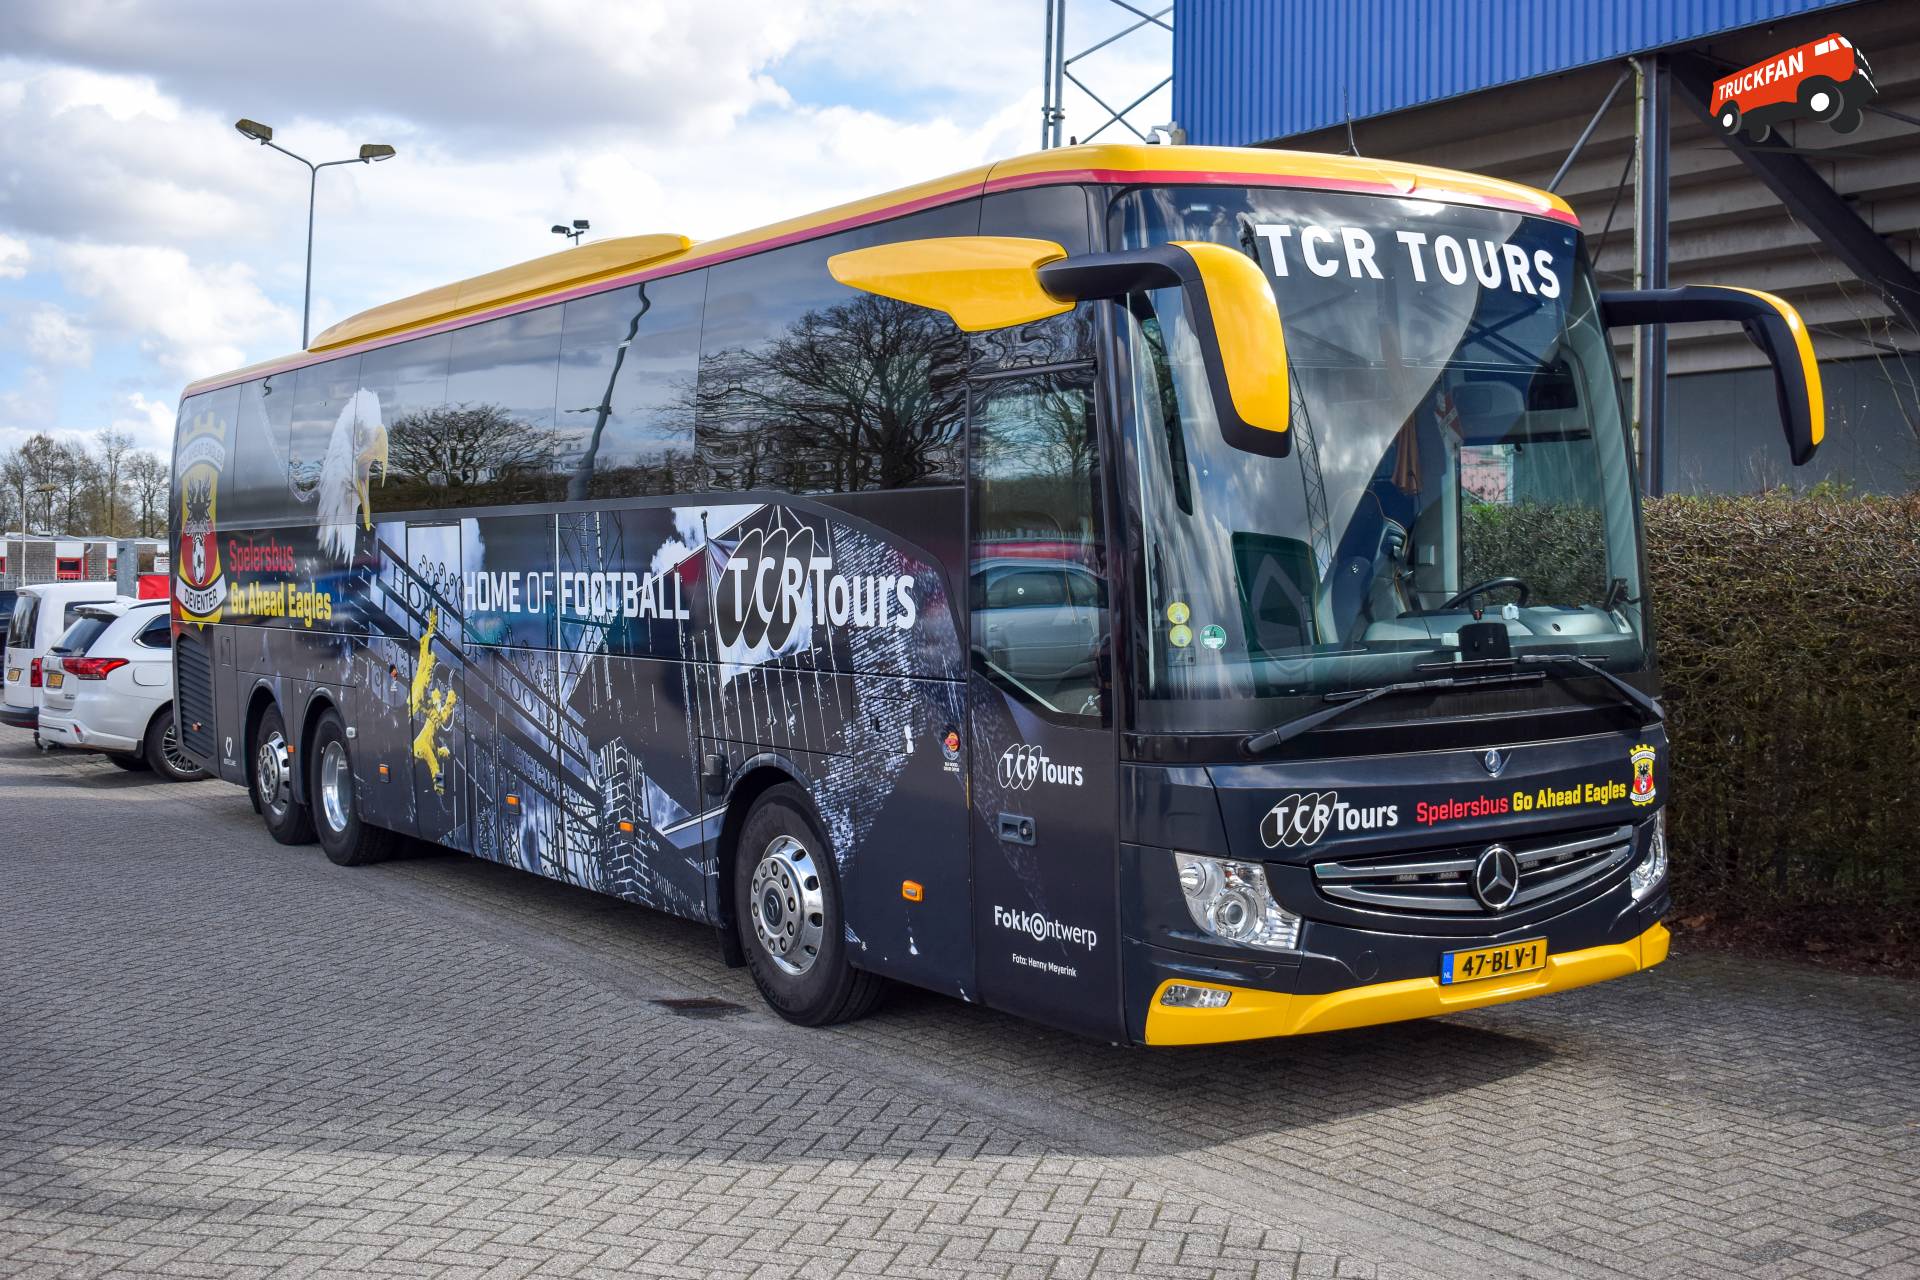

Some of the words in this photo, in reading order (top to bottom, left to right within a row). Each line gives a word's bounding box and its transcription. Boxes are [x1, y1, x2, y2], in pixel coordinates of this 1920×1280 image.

[1255, 223, 1385, 281] TCR
[1396, 230, 1561, 299] TOURS
[229, 537, 294, 579] Spelersbus
[184, 588, 218, 611] DEVENTER
[230, 581, 246, 615] Go
[248, 581, 285, 617] Ahead
[288, 582, 332, 628] Eagles
[463, 571, 521, 613] HOME
[526, 571, 554, 614] OF
[560, 571, 690, 620] FOOTBALL
[727, 556, 804, 625] TCR
[808, 556, 917, 630] Tours
[1002, 753, 1038, 781] TCR
[1039, 756, 1083, 787] Tours
[1271, 804, 1330, 836] TCR
[1333, 801, 1399, 831] Tours
[1416, 795, 1509, 827] Spelersbus
[1512, 791, 1533, 812] Go
[1536, 784, 1581, 809] Ahead
[1585, 780, 1626, 805] Eagles
[1012, 953, 1028, 966] Foto:
[1028, 957, 1048, 973] Henny
[1048, 962, 1077, 978] Meyerink
[1443, 971, 1452, 979] NL
[1462, 945, 1538, 977] 47-BLV-1
